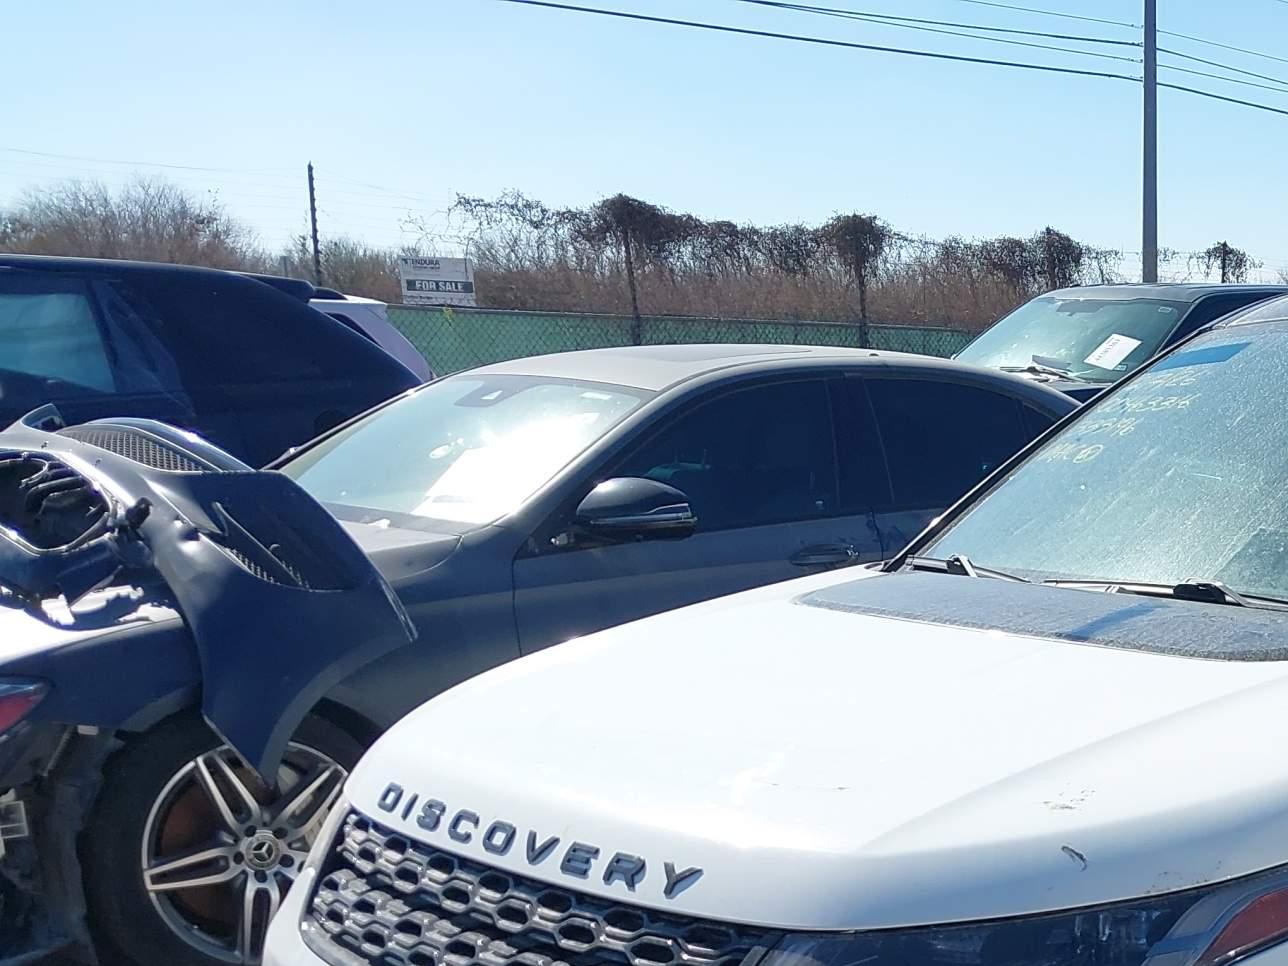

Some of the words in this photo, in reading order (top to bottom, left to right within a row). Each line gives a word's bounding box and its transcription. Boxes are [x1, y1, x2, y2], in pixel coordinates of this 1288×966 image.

[415, 280, 436, 291] FOR
[438, 281, 464, 292] SALE
[377, 782, 704, 899] DISCOVERY
